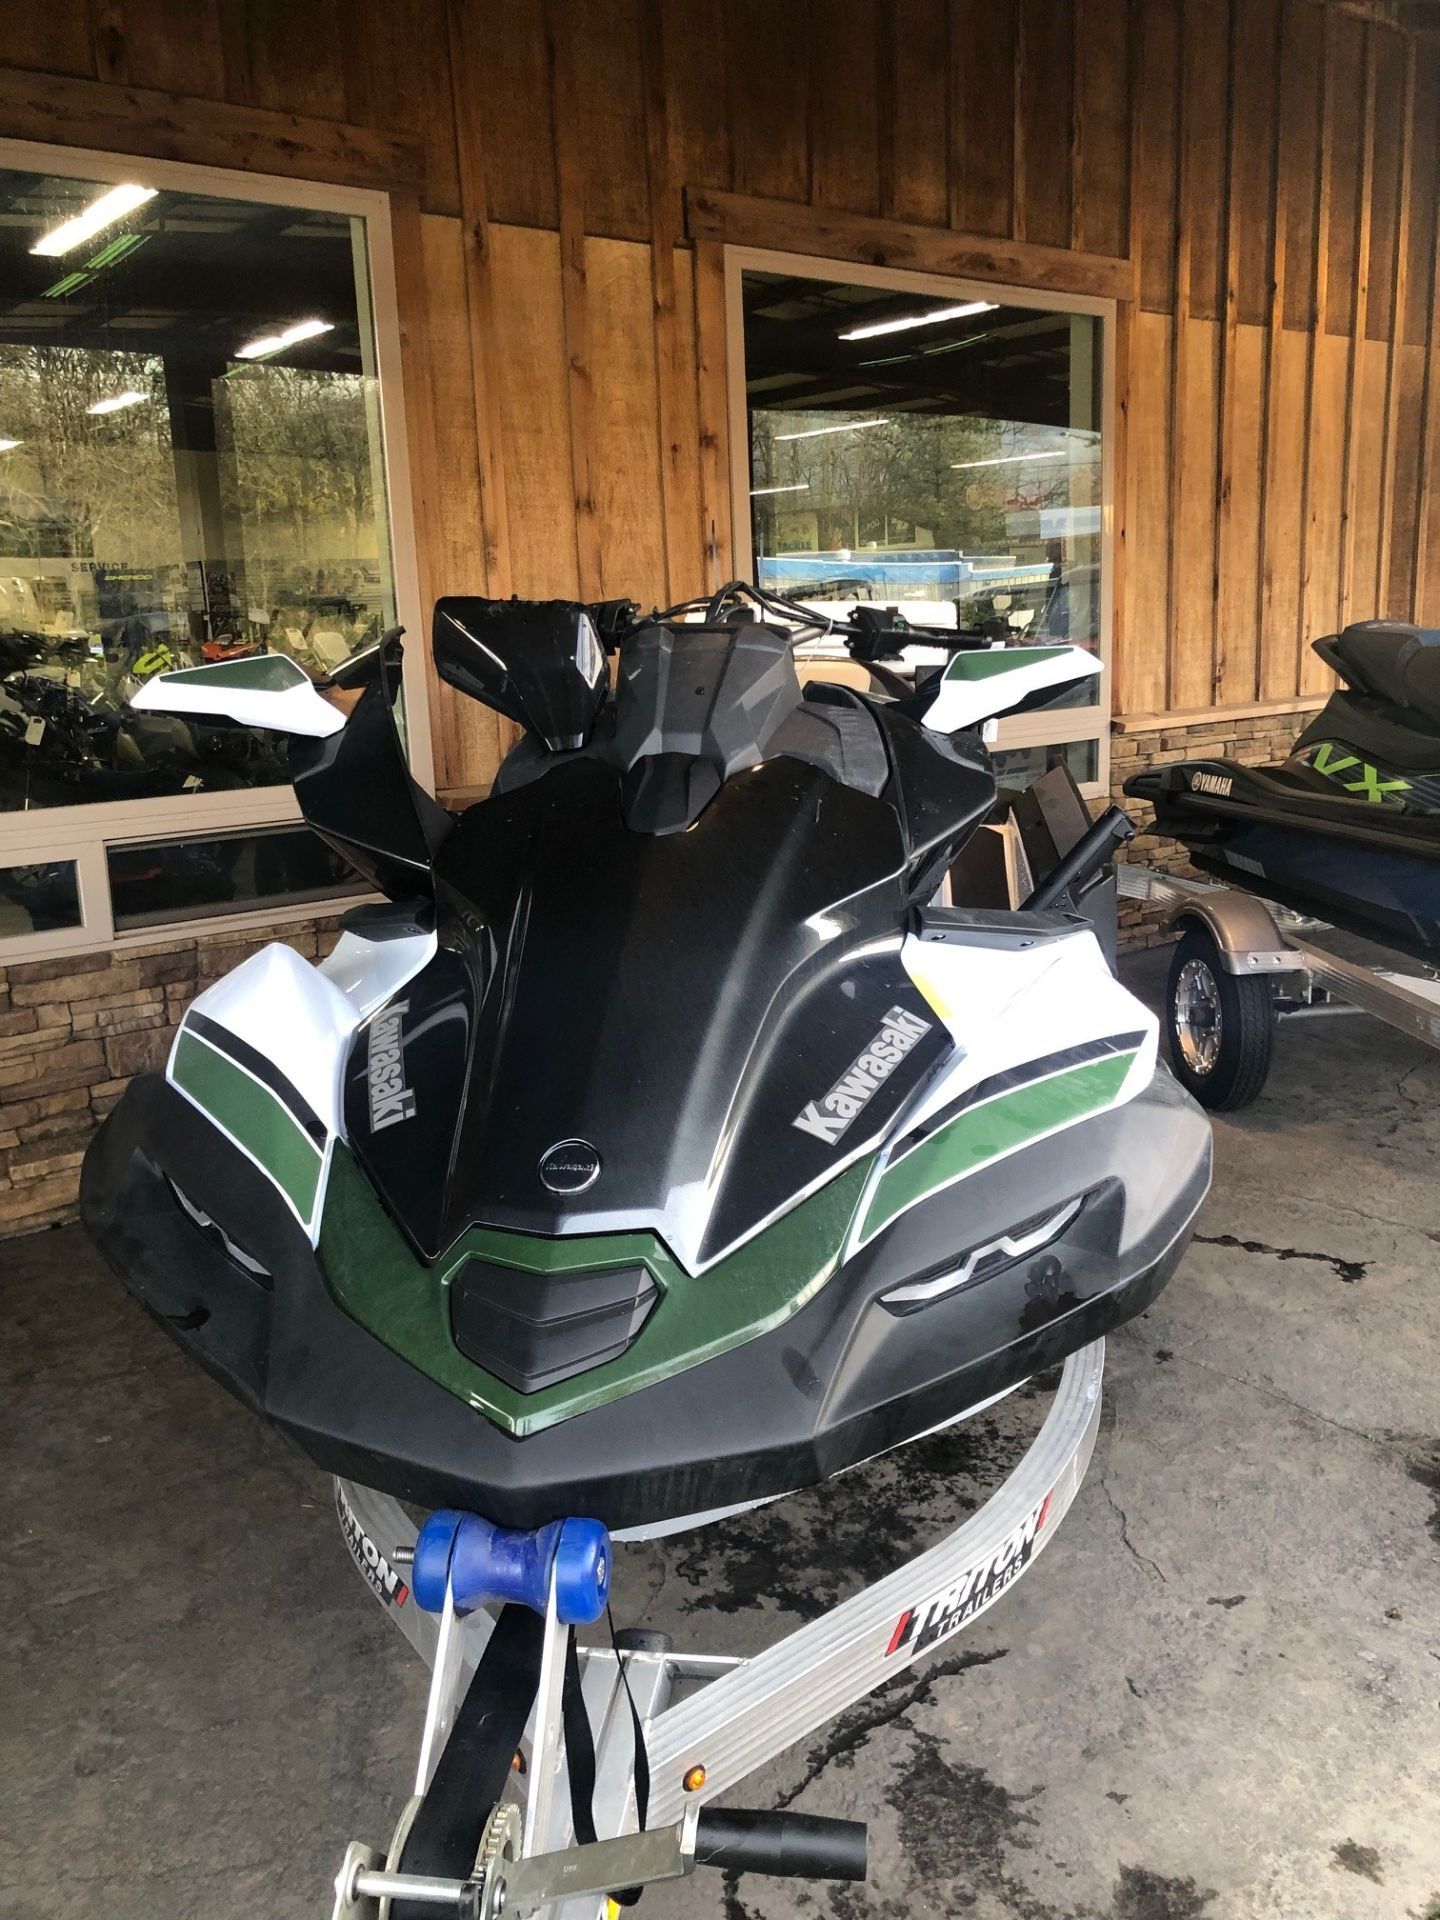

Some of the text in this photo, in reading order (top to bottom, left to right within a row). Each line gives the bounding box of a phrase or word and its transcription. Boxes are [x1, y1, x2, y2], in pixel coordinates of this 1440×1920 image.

[1200, 773, 1233, 797] YAMAHA
[1313, 743, 1413, 803] VX
[370, 1000, 415, 1132] Kawasaki
[792, 1005, 931, 1144] Kawasaki
[909, 1504, 1042, 1641] TRITON
[937, 1554, 1023, 1638] TRAILERS
